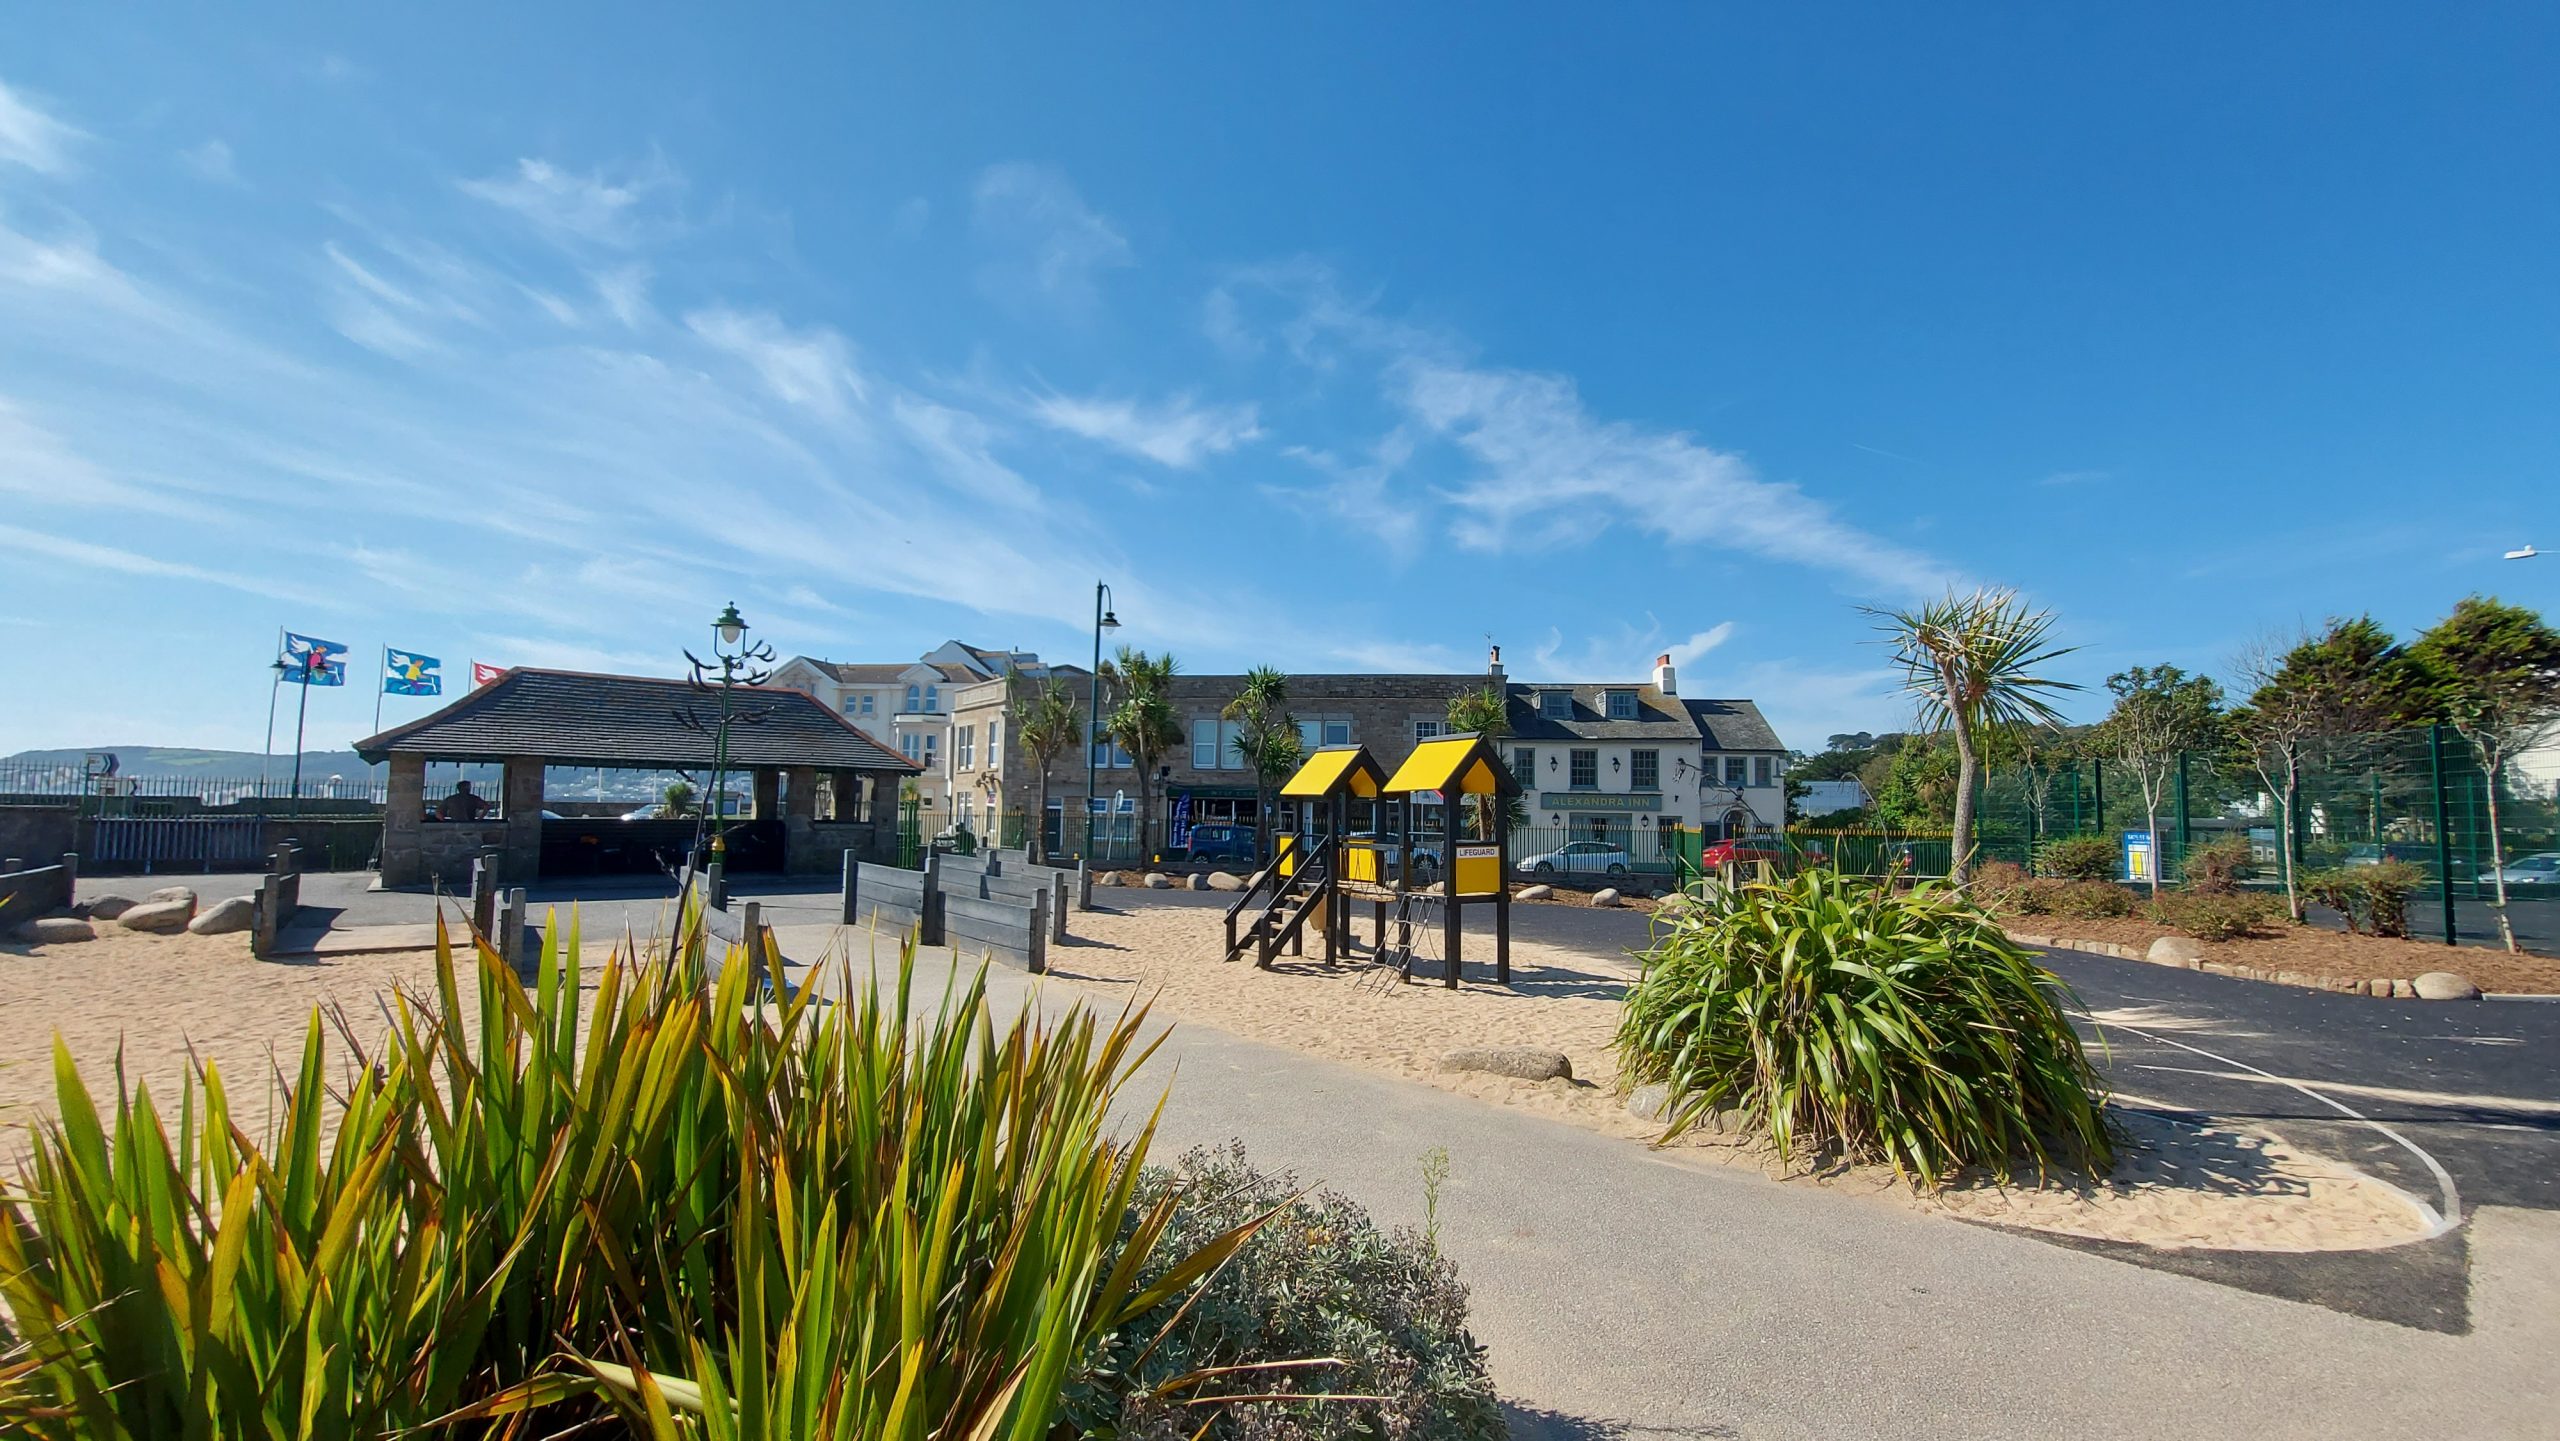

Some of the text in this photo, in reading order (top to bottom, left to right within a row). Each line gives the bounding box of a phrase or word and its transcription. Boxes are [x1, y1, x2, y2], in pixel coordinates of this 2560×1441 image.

[1551, 797, 1650, 807] ALEXANDRA INN
[1459, 848, 1496, 857] LIFEGUARD
